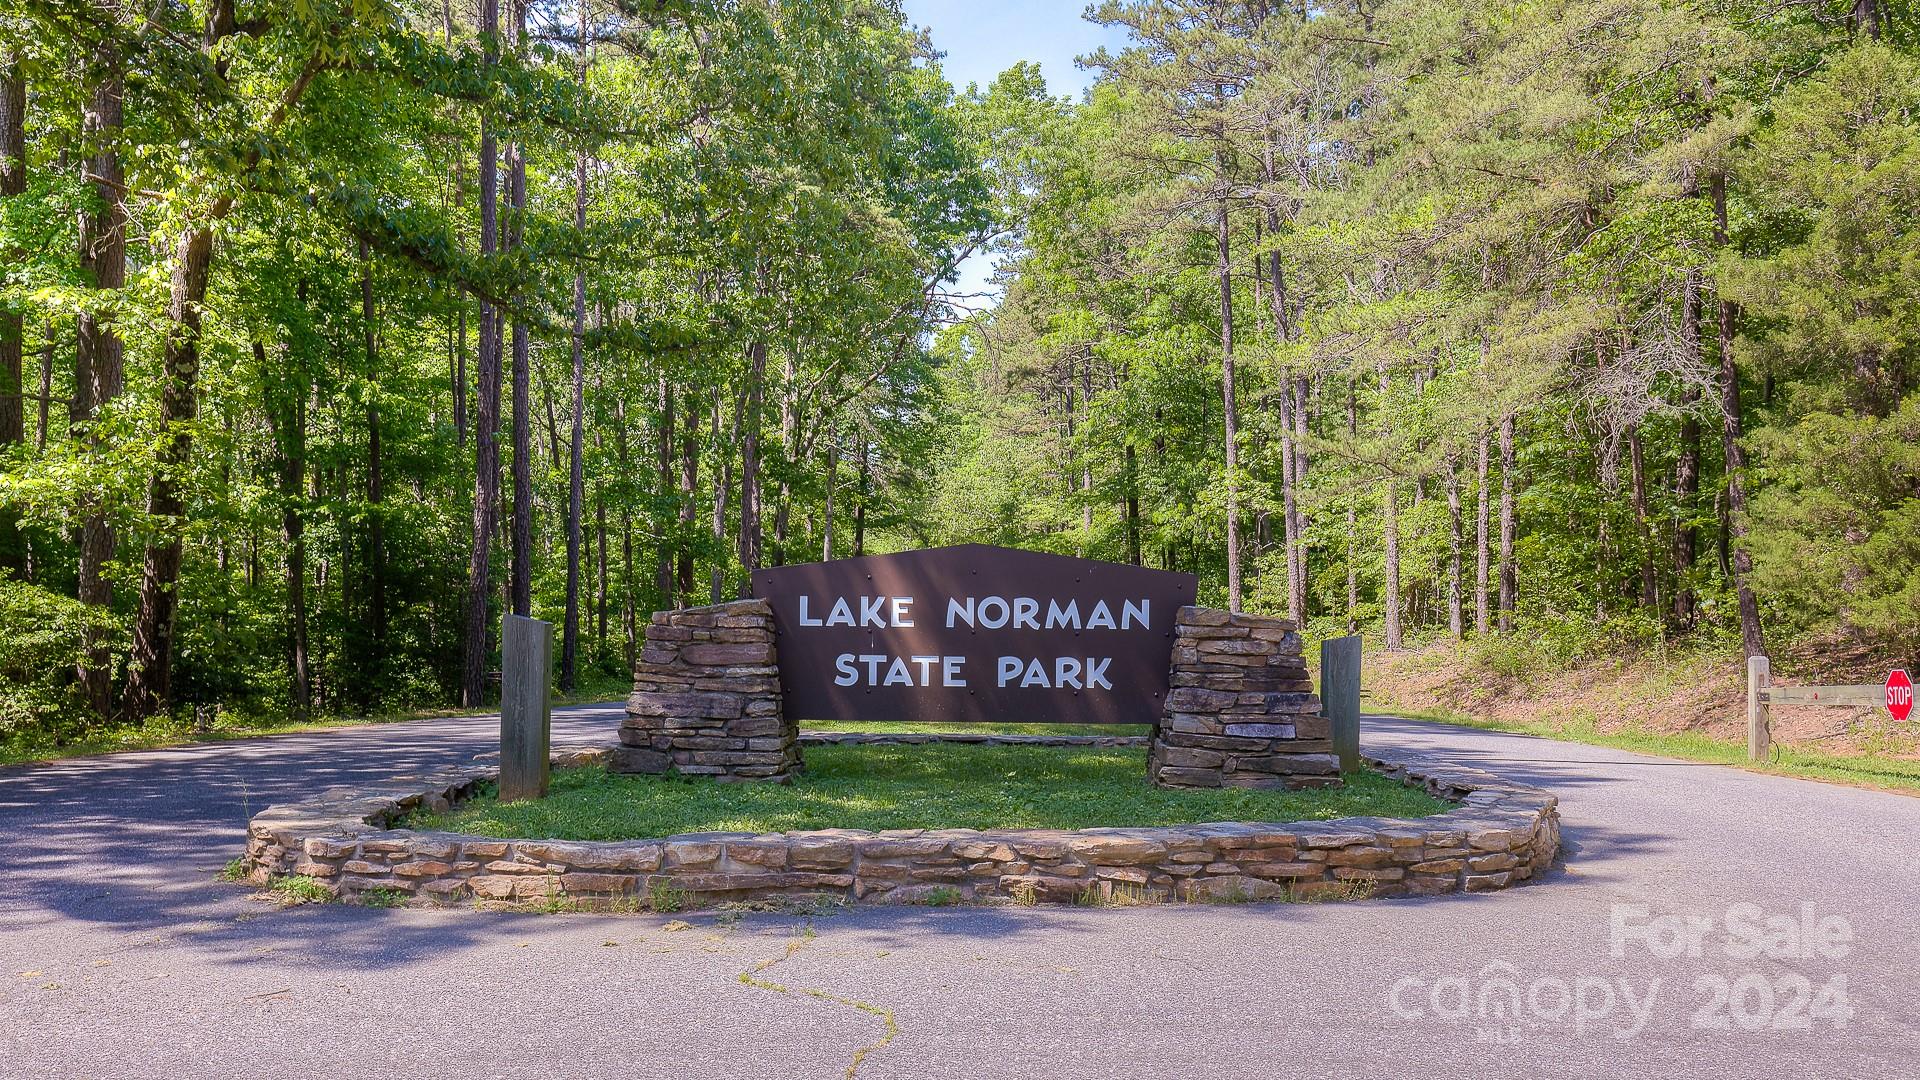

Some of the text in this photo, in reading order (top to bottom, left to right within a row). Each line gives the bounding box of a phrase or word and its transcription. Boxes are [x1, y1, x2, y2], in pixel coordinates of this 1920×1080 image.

[799, 595, 1151, 631] LAKE NORMAN
[834, 653, 1114, 690] STATE PARK
[1887, 686, 1911, 705] STOP
